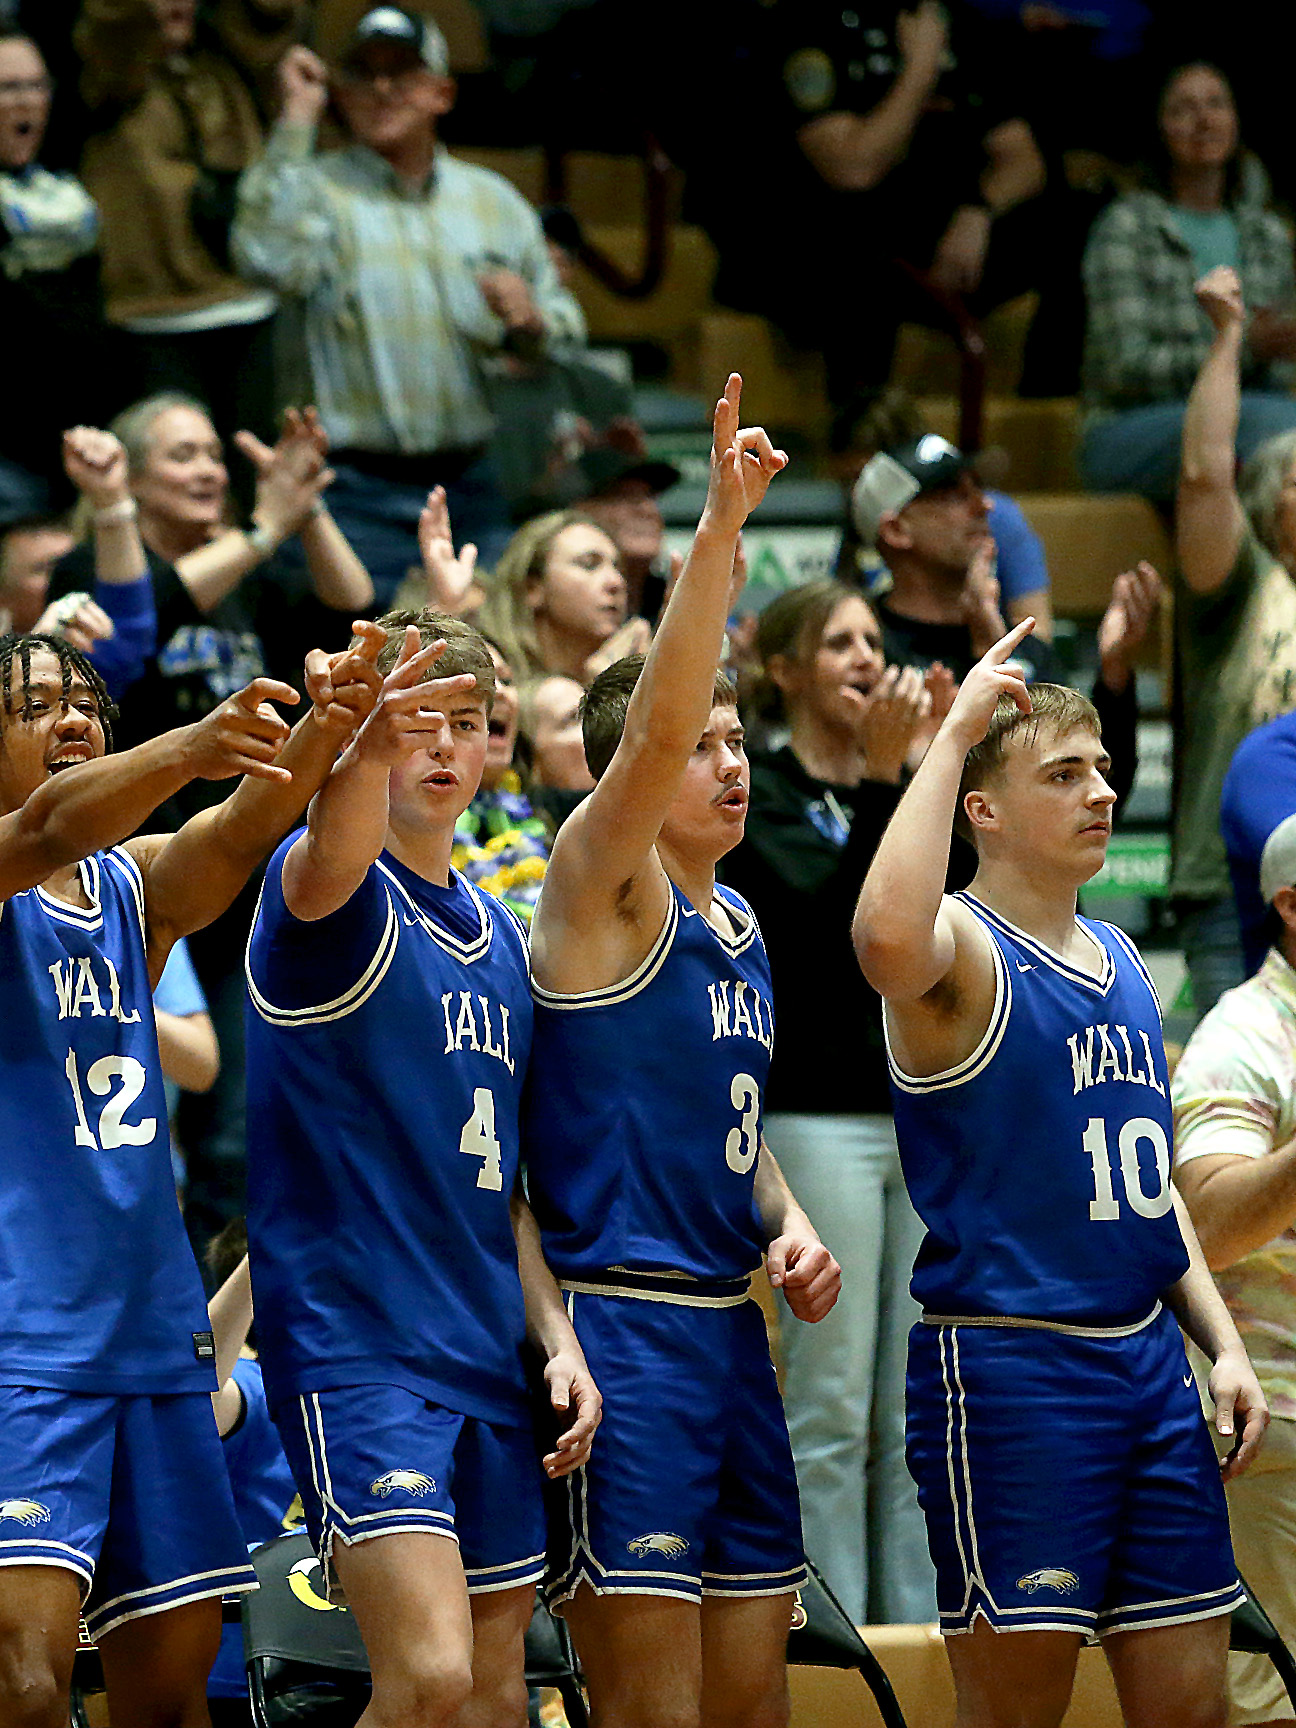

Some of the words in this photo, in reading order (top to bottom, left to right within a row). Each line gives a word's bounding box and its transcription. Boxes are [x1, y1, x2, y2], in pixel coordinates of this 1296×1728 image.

[65, 1046, 157, 1151] 12
[1066, 1023, 1167, 1100] WALL
[459, 1087, 503, 1191] 4
[725, 1072, 760, 1175] 3
[1082, 1117, 1174, 1221] 10
